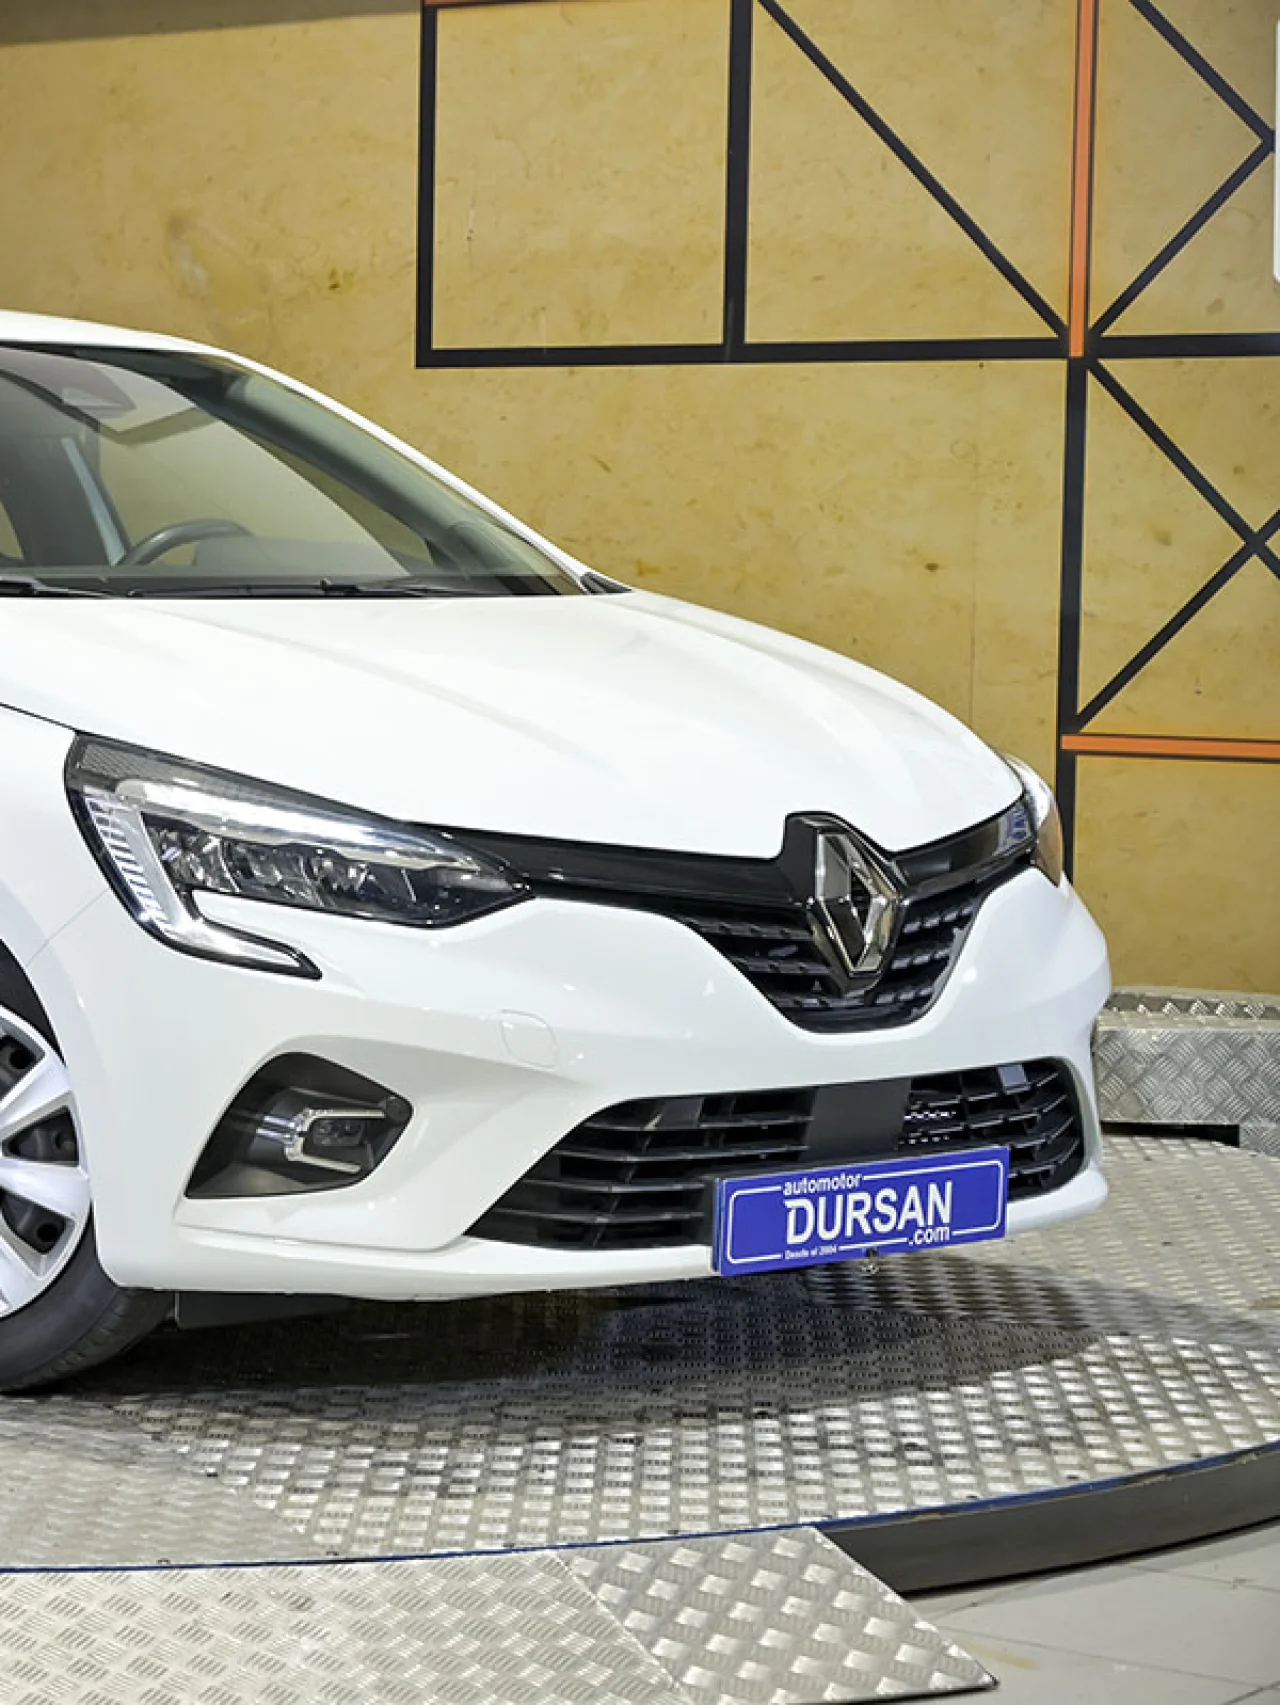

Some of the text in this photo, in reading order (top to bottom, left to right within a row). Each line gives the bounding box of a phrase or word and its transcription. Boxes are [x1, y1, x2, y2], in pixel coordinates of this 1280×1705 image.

[783, 1173, 862, 1195] automotor
[784, 1180, 953, 1244] DURSAN
[908, 1226, 950, 1246] .com
